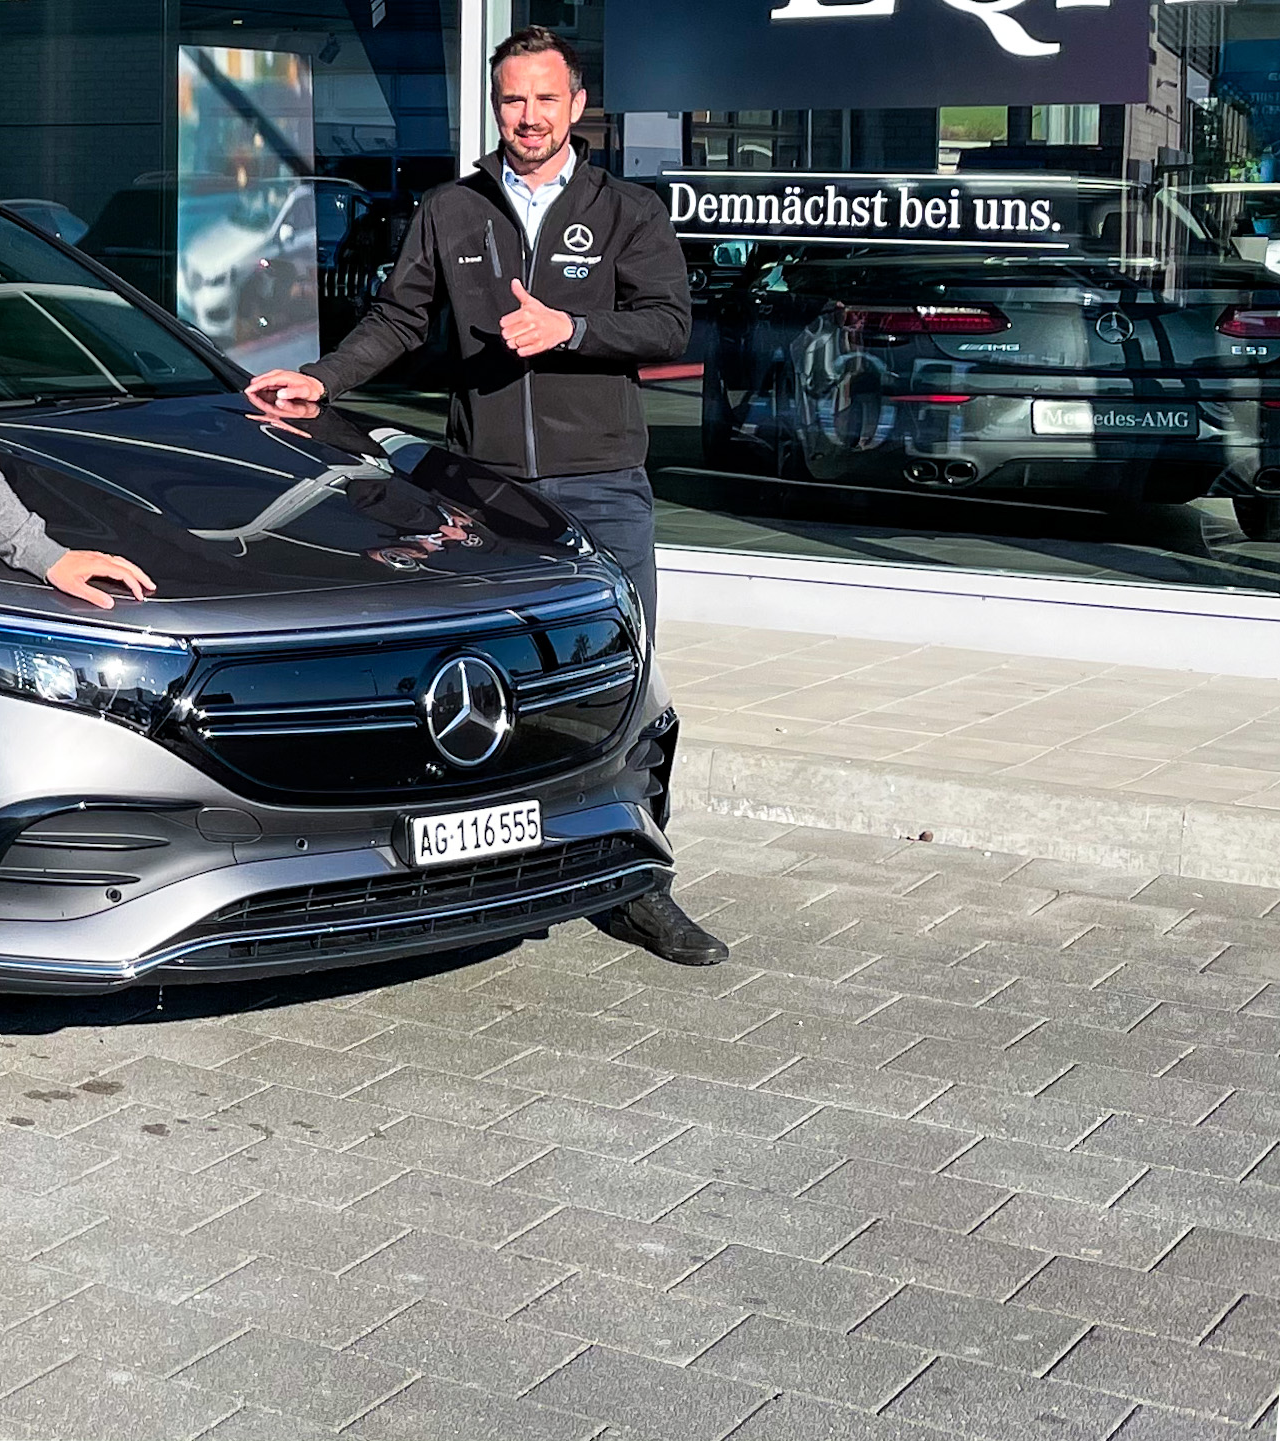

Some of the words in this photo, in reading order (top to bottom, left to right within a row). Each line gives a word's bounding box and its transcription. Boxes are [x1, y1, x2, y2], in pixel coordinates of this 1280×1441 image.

[669, 182, 888, 228] Demnächst
[899, 187, 960, 230] bei
[974, 199, 1062, 233] uns.
[563, 265, 589, 279] EQ
[1046, 410, 1189, 428] Meedes-AMG
